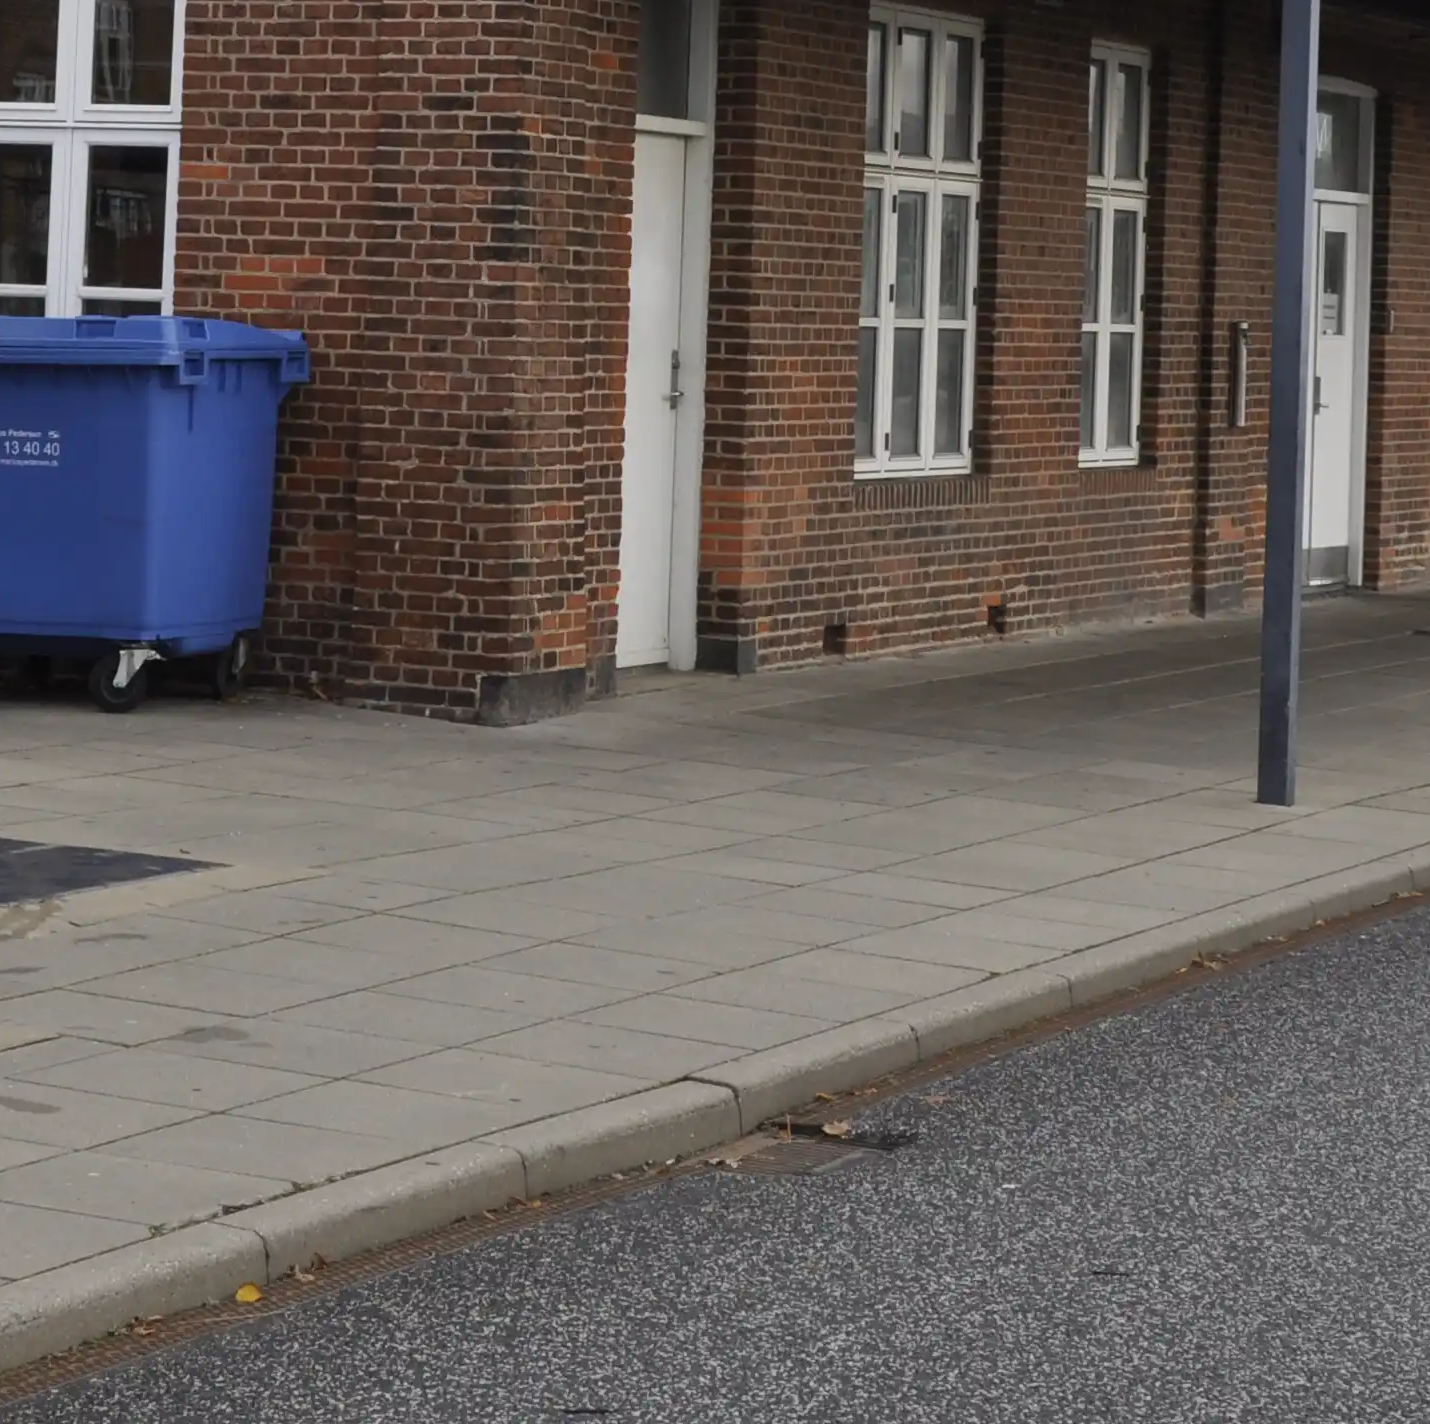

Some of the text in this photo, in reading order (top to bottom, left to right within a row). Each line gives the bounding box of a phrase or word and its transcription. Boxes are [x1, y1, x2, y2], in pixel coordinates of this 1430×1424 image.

[8, 429, 42, 438] Pedersen
[4, 440, 20, 455] 13
[23, 441, 40, 456] 40
[43, 442, 60, 456] 40
